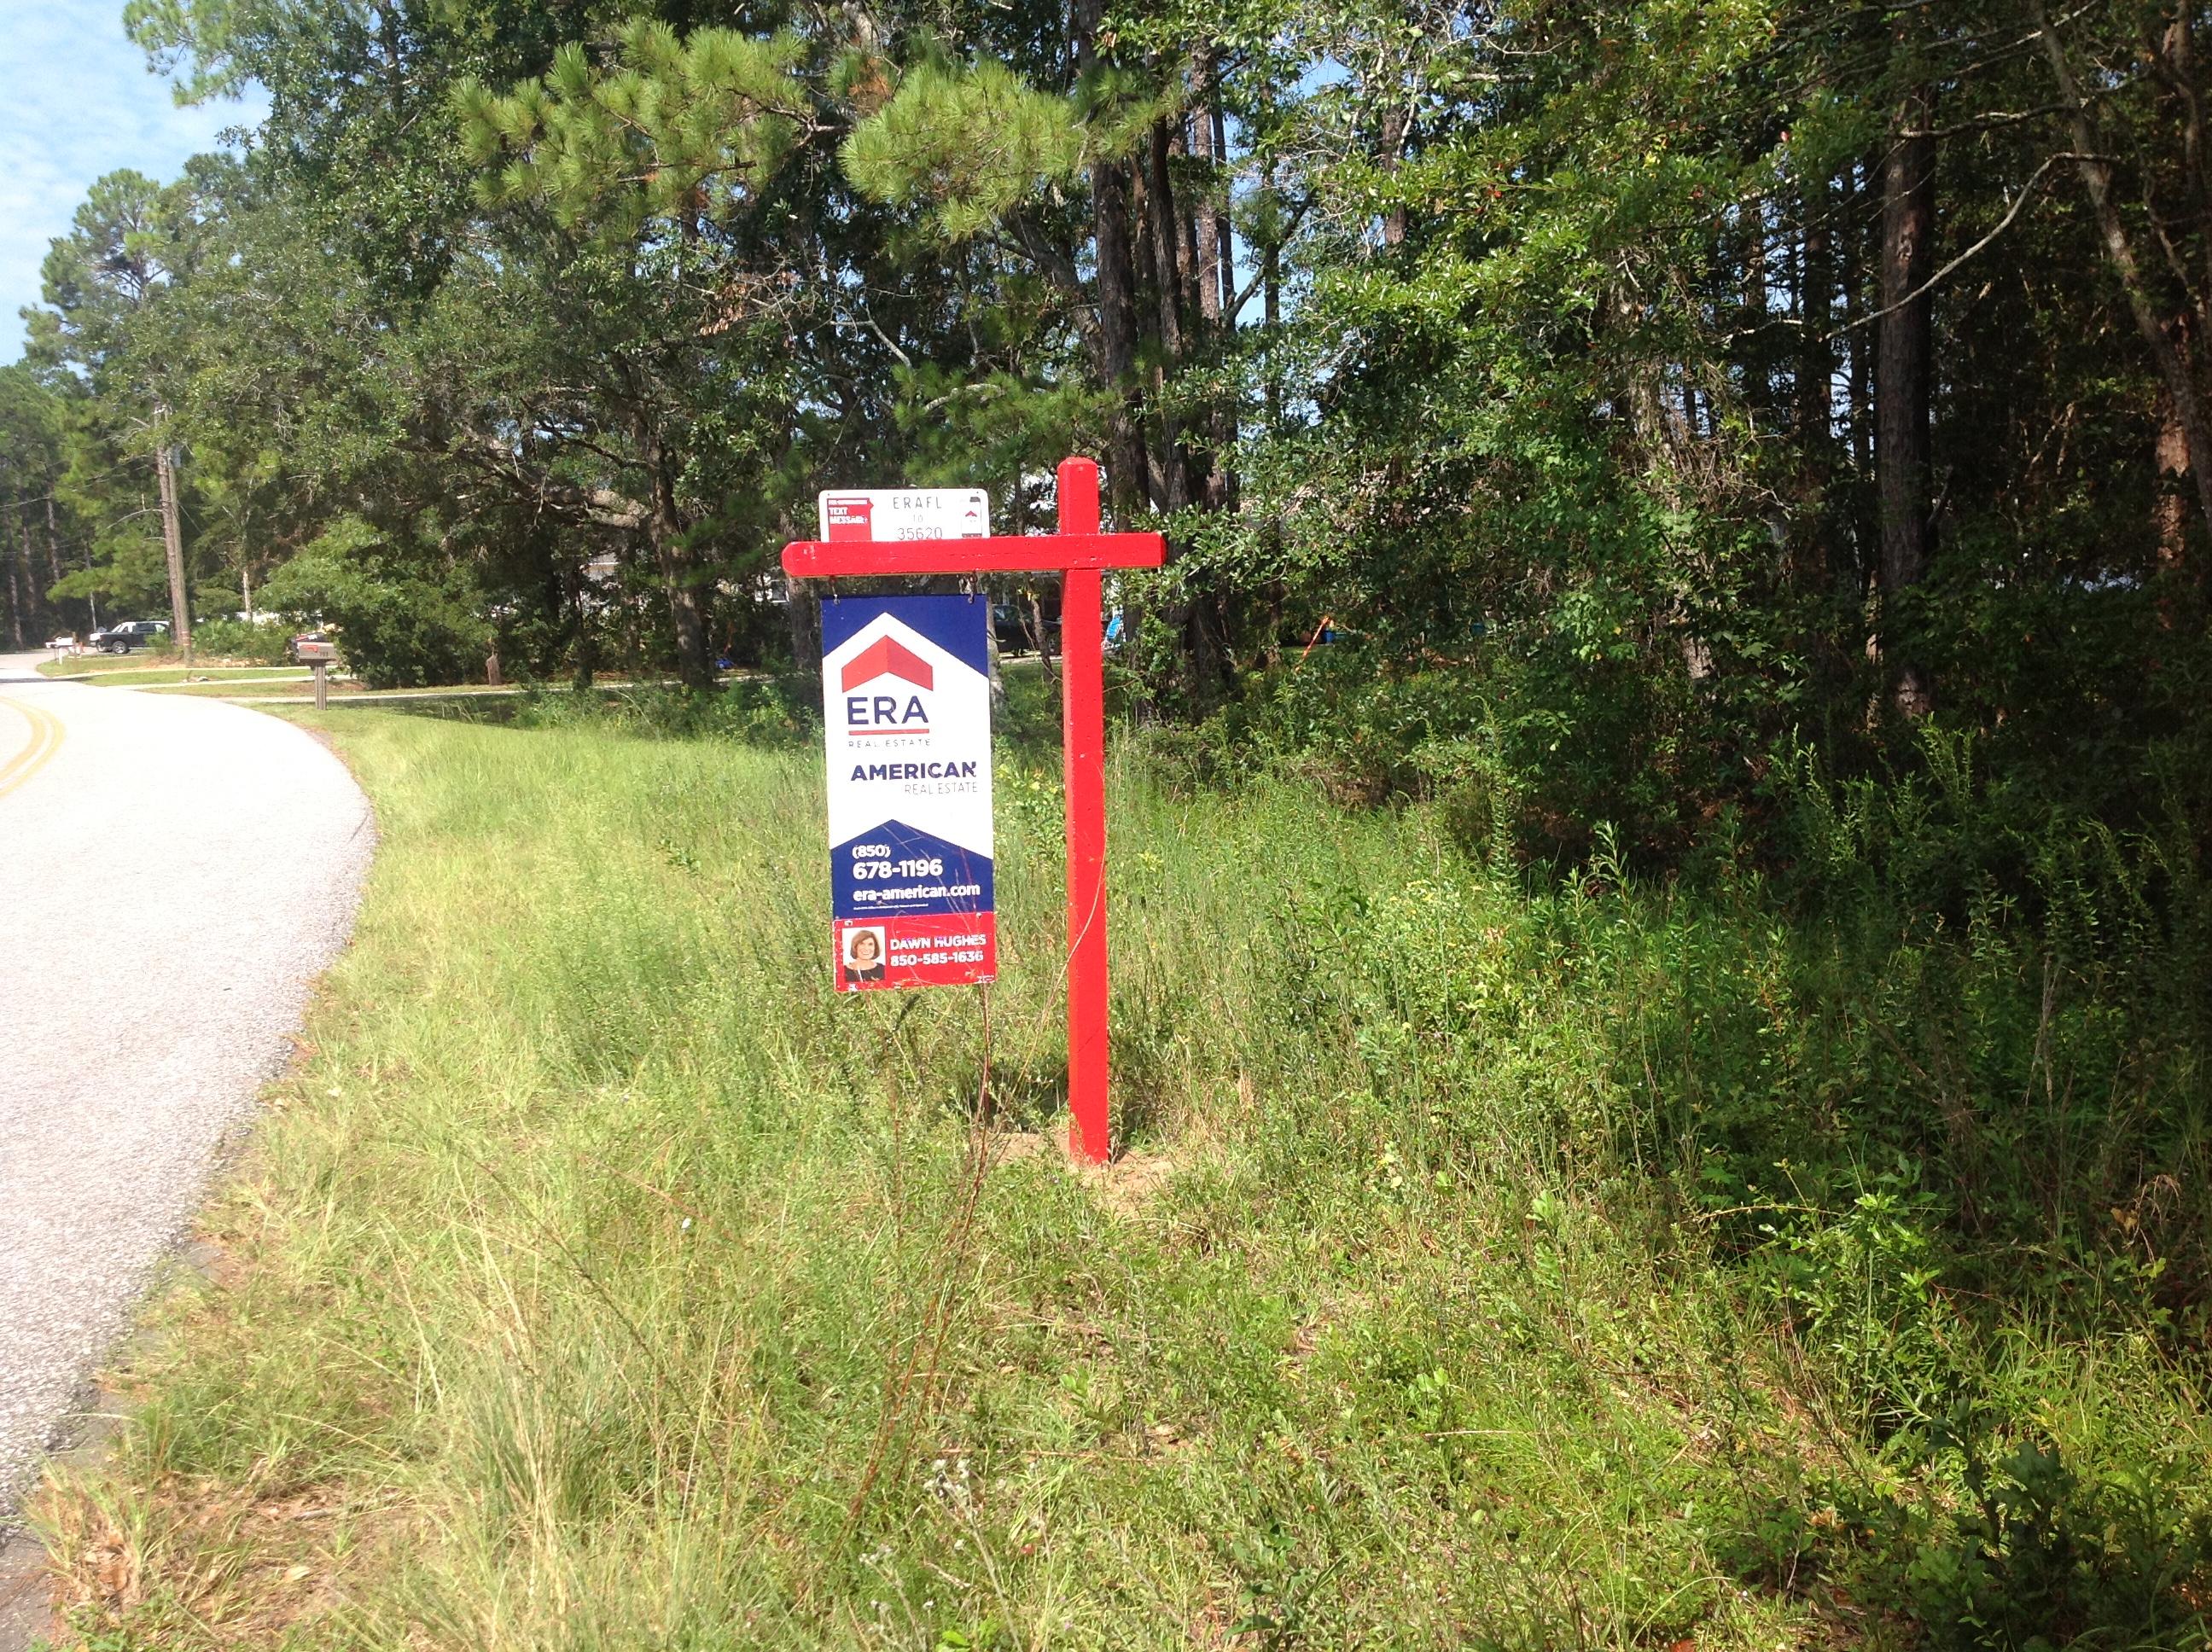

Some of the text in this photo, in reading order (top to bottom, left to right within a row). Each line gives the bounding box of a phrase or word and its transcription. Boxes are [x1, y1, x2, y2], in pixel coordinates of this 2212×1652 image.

[894, 497, 942, 509] ERAFL
[897, 527, 942, 540] 35620
[847, 695, 928, 724] ERA
[848, 738, 931, 748] REAL ESTATE
[851, 761, 977, 781] AMERICAN
[905, 782, 978, 794] REAL ESTATE
[853, 844, 891, 858] (850)
[853, 859, 943, 881] 678-1196
[853, 884, 981, 901] era-american.com
[890, 934, 986, 951] DAWN HUGHES
[890, 951, 984, 967] 850-585-1636
